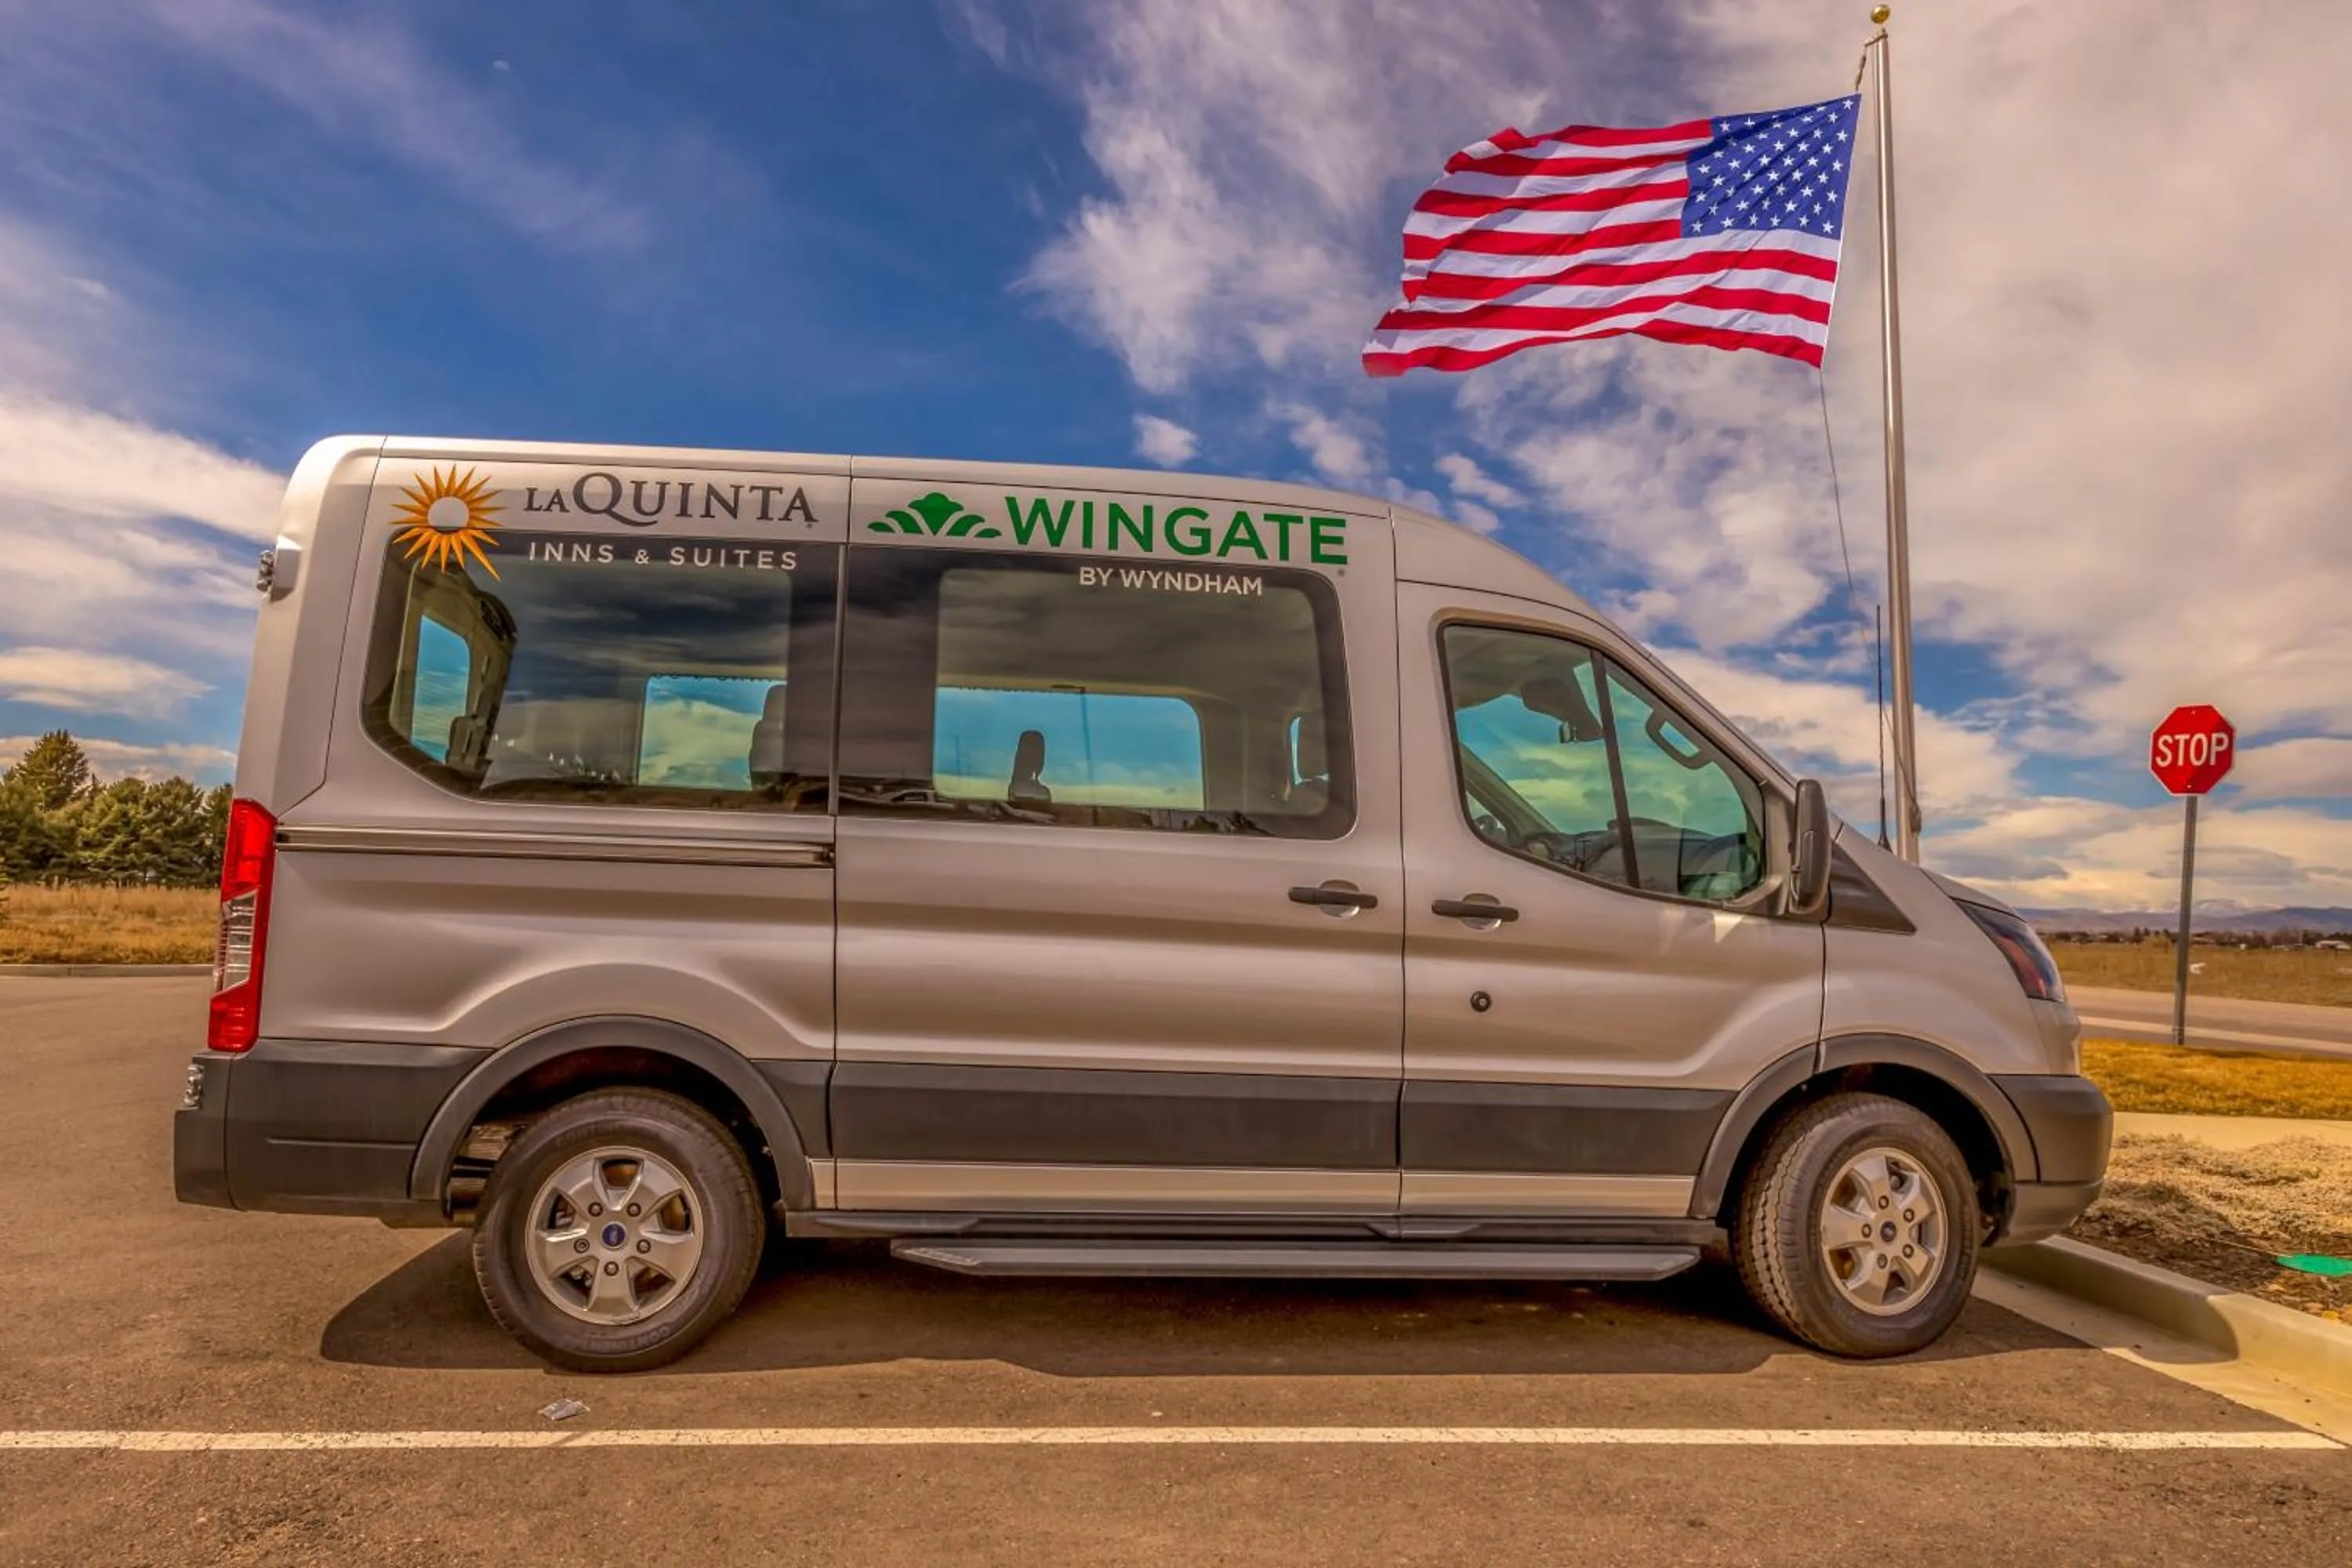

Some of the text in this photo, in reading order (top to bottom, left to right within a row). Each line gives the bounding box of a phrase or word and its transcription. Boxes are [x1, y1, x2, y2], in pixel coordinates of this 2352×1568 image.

[524, 472, 819, 527] LA QUINTA
[1004, 496, 1348, 565] WINGATE
[528, 542, 797, 570] INNS & SUITES
[1079, 567, 1262, 596] BY WYNDHAM
[2155, 732, 2230, 768] STOP
